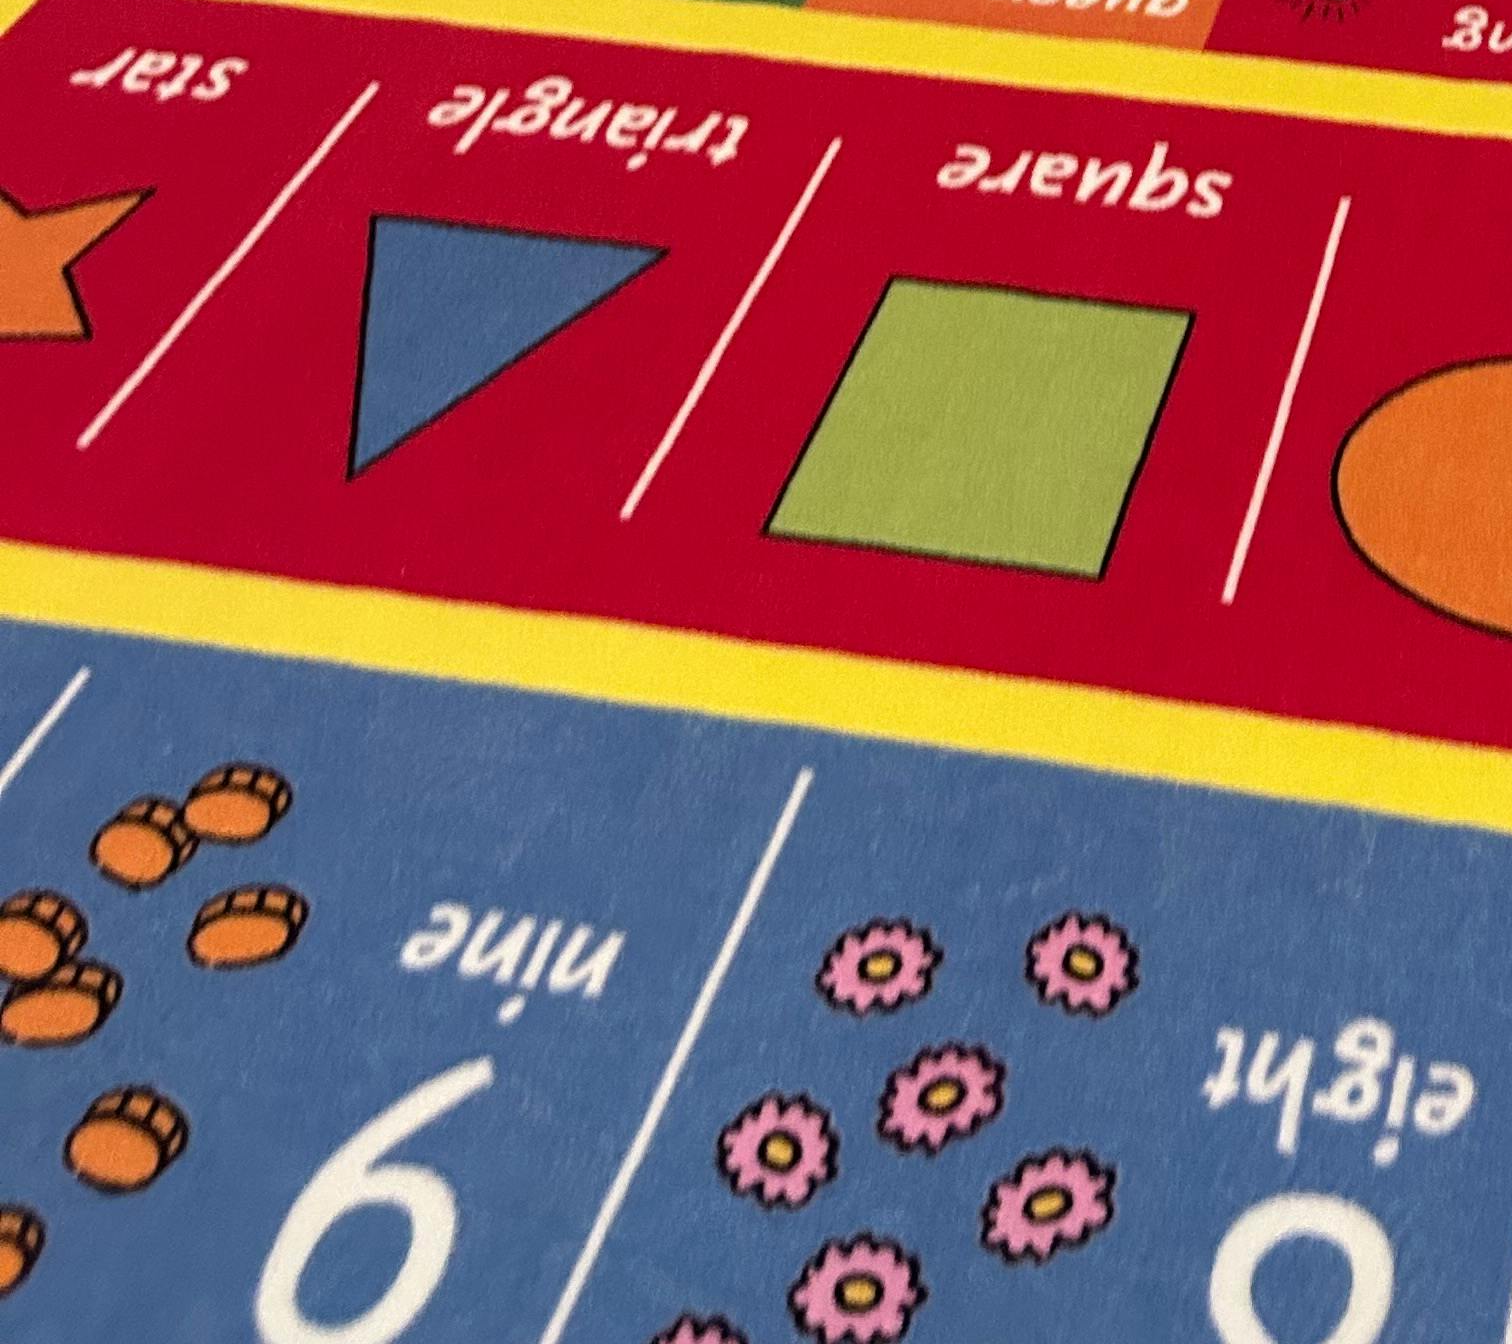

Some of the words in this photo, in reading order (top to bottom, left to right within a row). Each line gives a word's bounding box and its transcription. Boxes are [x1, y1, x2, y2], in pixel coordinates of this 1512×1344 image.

[70, 46, 250, 102] star
[428, 75, 749, 172] triangle
[936, 140, 1234, 218] square
[400, 900, 628, 1024] nine
[1201, 1016, 1476, 1168] eight
